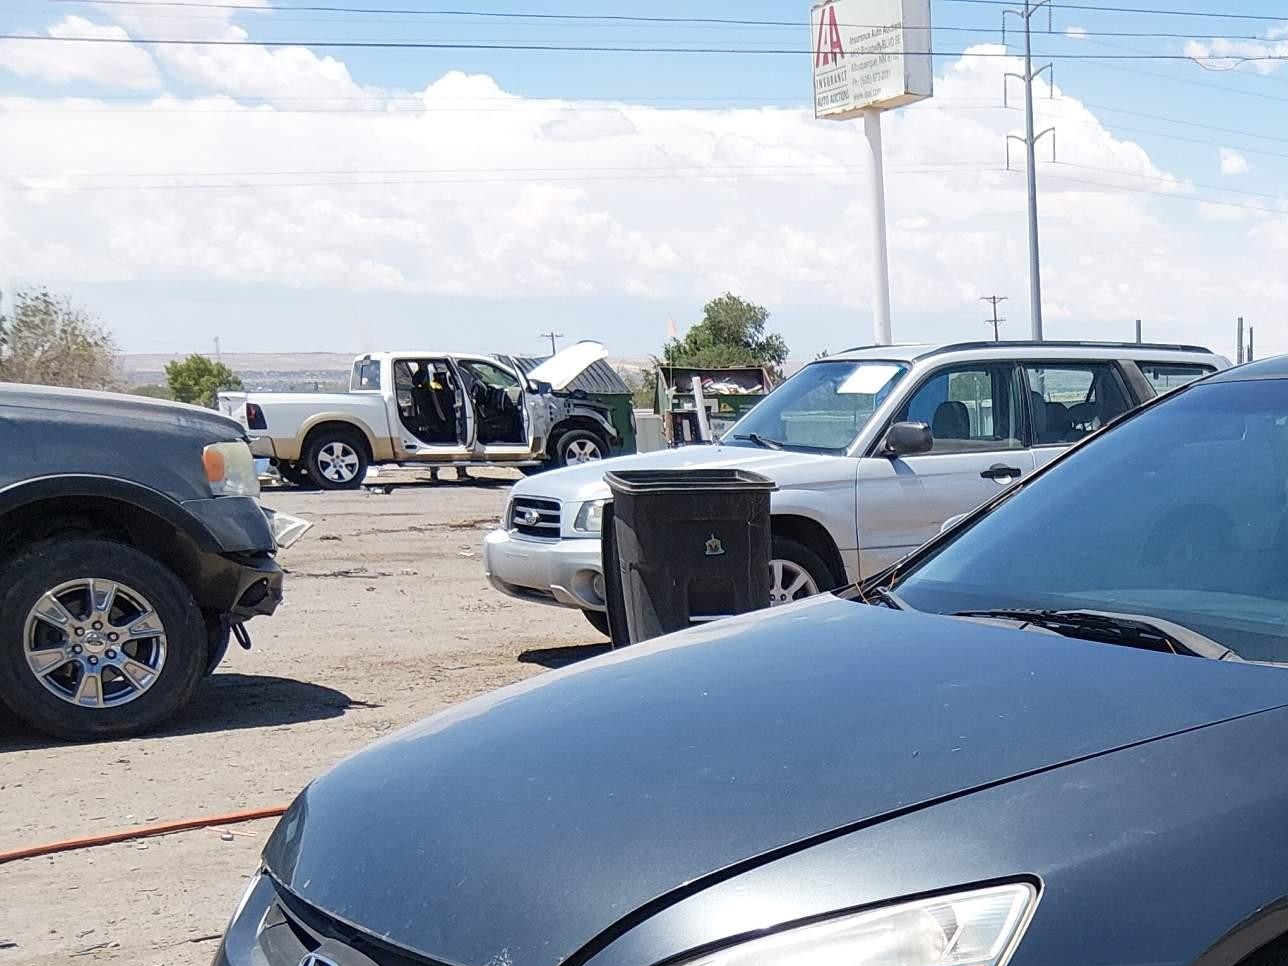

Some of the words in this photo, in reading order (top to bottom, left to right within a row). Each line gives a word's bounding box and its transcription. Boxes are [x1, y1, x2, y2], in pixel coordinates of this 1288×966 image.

[816, 70, 847, 89] INSURANCE
[817, 94, 829, 107] AUTO
[830, 88, 850, 104] AUCTIONS
